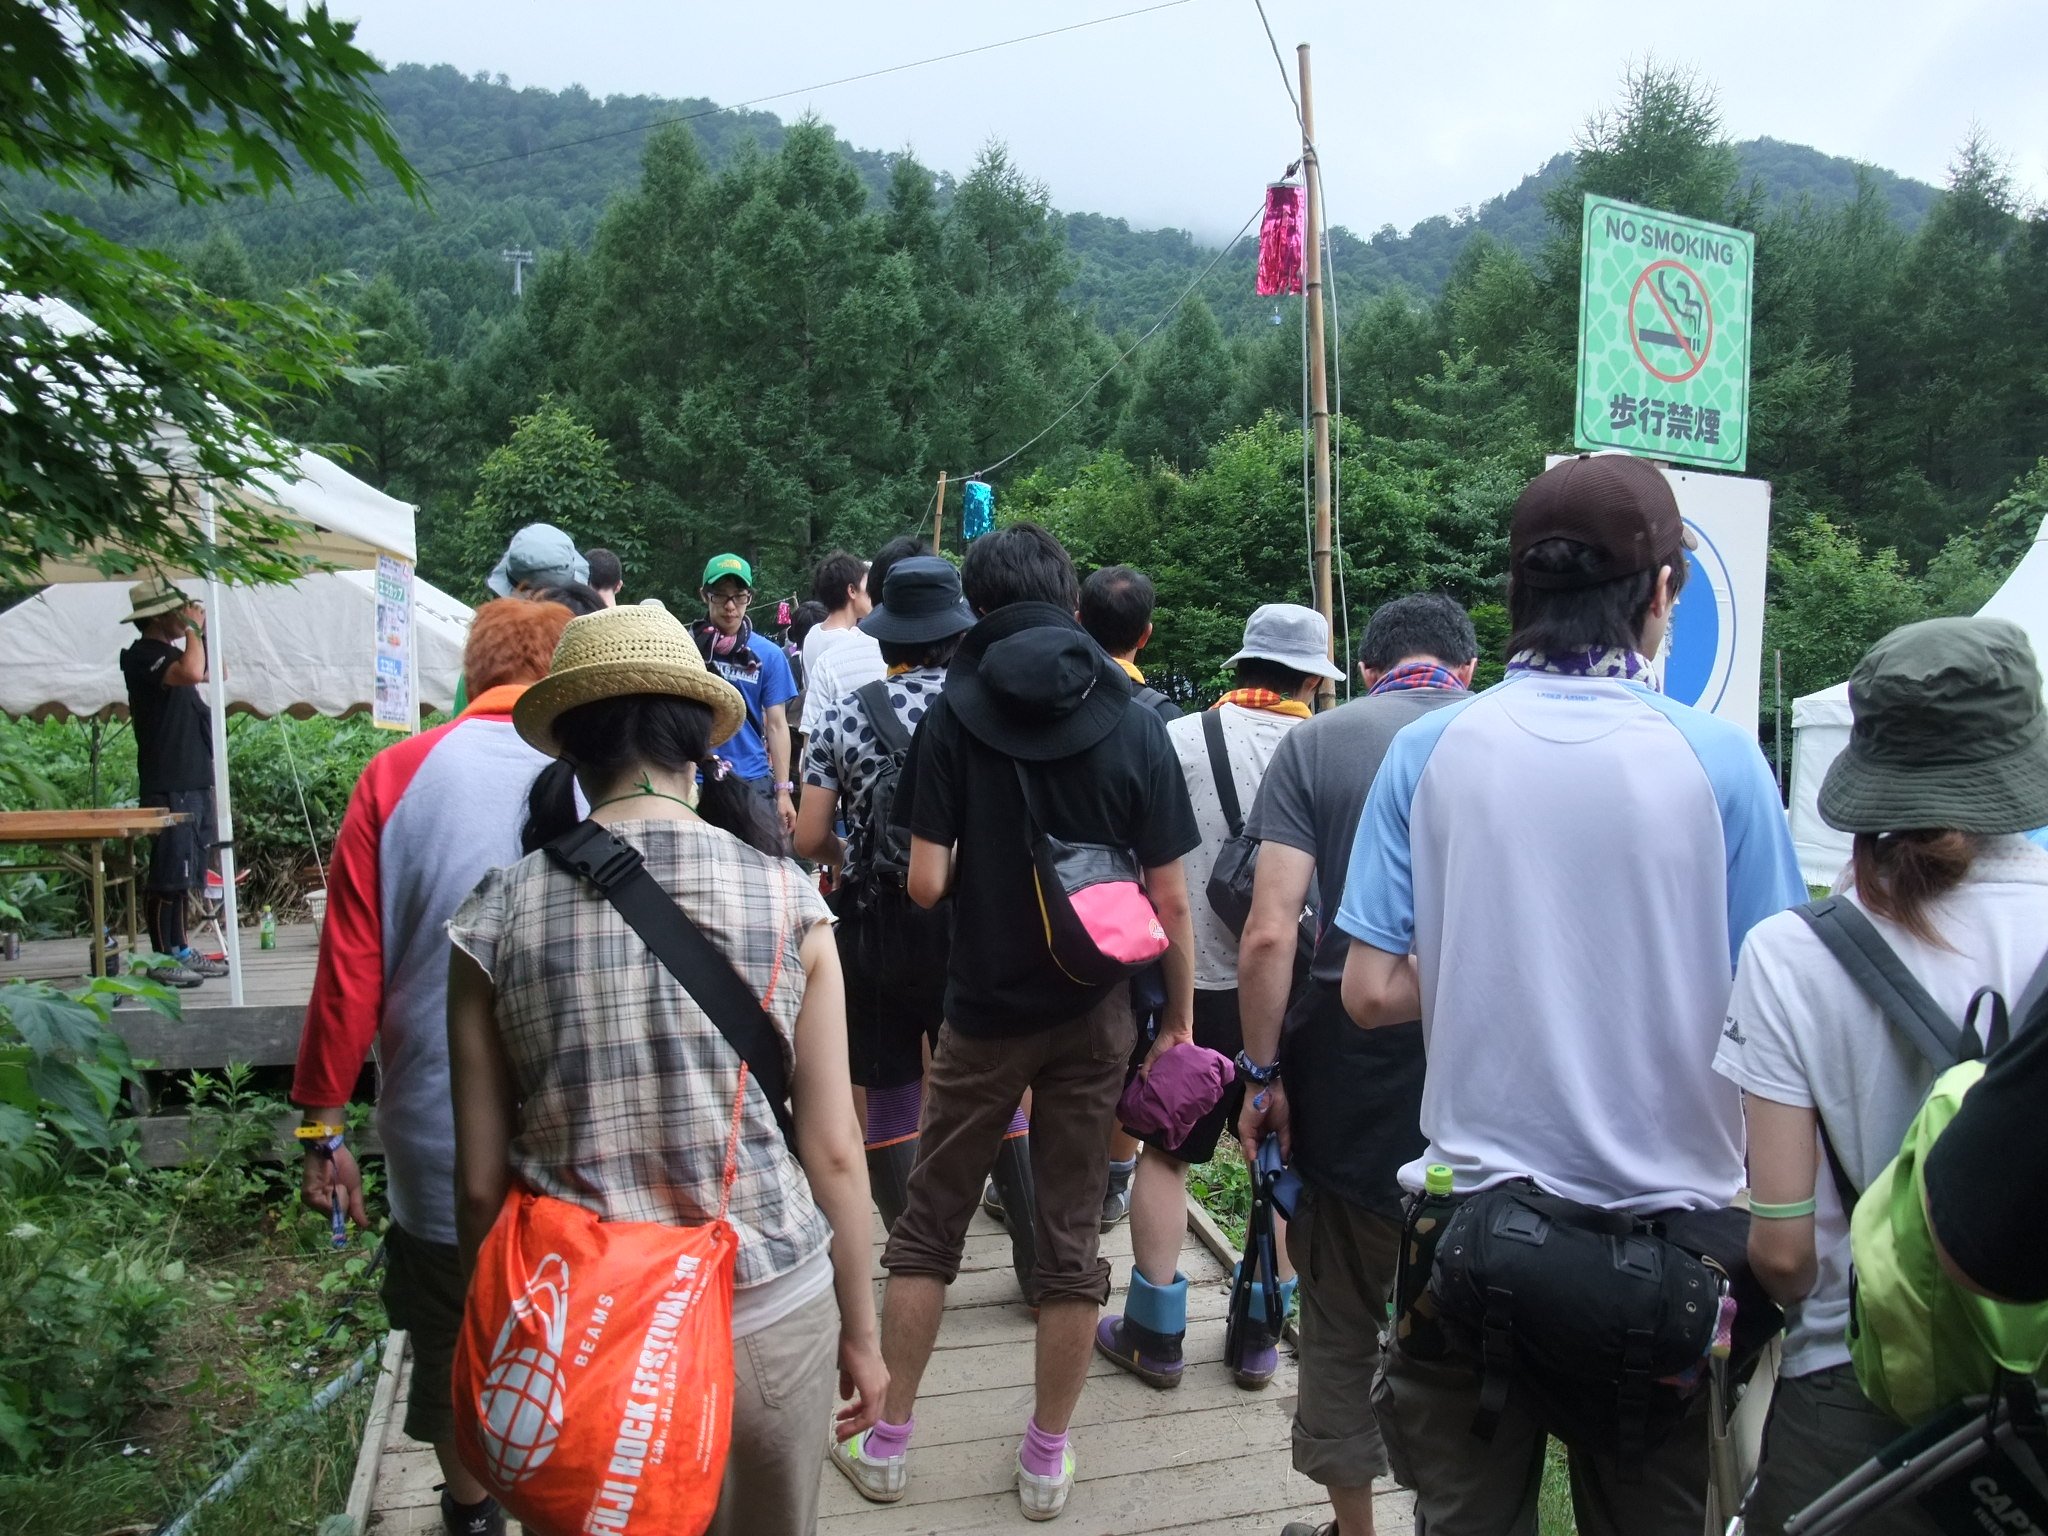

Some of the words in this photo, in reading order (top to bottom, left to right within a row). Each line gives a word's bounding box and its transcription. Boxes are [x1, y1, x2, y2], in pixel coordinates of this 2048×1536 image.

[1605, 215, 1637, 243] NO
[1641, 224, 1734, 266] SMOKING
[1610, 392, 1721, 445] 歩行禁煙
[573, 1294, 614, 1367] BEAMS
[631, 1289, 691, 1397] FESTIVAL
[608, 1399, 657, 1477] ROCK
[589, 1479, 638, 1536] FUJI
